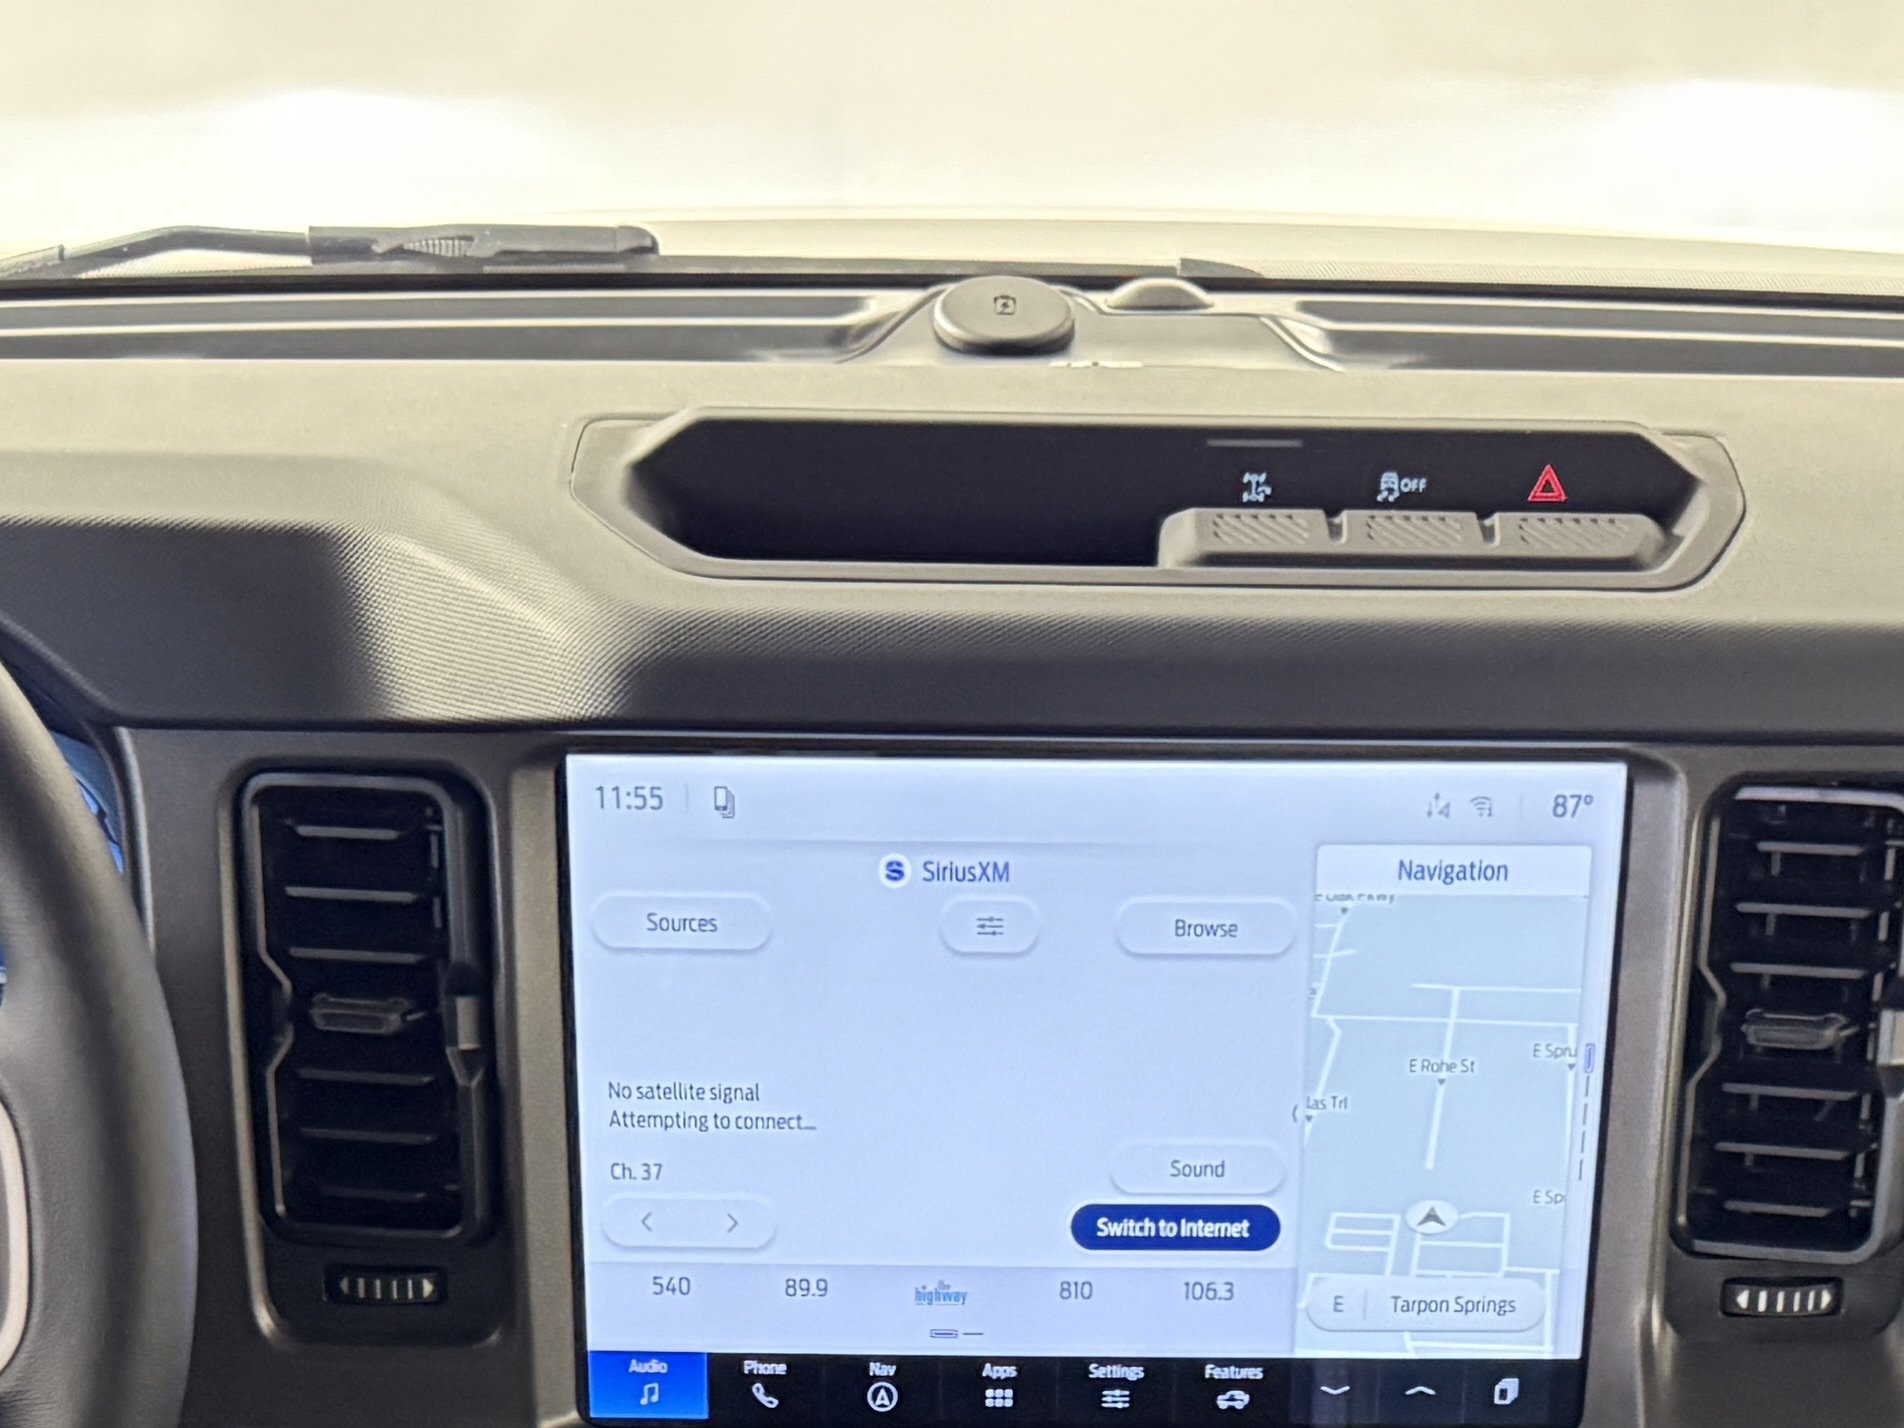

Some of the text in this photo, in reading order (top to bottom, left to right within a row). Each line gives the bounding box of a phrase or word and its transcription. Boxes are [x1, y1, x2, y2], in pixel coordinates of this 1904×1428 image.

[1400, 477, 1428, 493] OFF
[594, 785, 664, 812] 11:55
[1551, 793, 1594, 819] 87°
[922, 860, 1011, 883] SiriusXM
[1397, 859, 1509, 884] Navigation
[646, 912, 718, 934] Sources
[1174, 919, 1239, 939] Browse
[608, 1081, 761, 1104] No satellite signal
[609, 1110, 709, 1133] Attempting
[713, 1113, 731, 1131] to
[609, 1162, 664, 1181] Ch. 37
[1169, 1159, 1226, 1178] Sound
[1095, 1216, 1250, 1239] Switch to Internet
[652, 1276, 692, 1297] 540
[784, 1278, 829, 1298] 89.9
[1058, 1280, 1094, 1300] 810
[1183, 1281, 1235, 1301] 106.3
[1332, 1295, 1517, 1317] E Tarpon Springs
[628, 1359, 668, 1374] Audio
[743, 1360, 788, 1376] Phone
[868, 1362, 897, 1377] Nav
[981, 1363, 1018, 1380] Apps
[1087, 1363, 1145, 1381] Settings
[1204, 1364, 1265, 1380] Features
